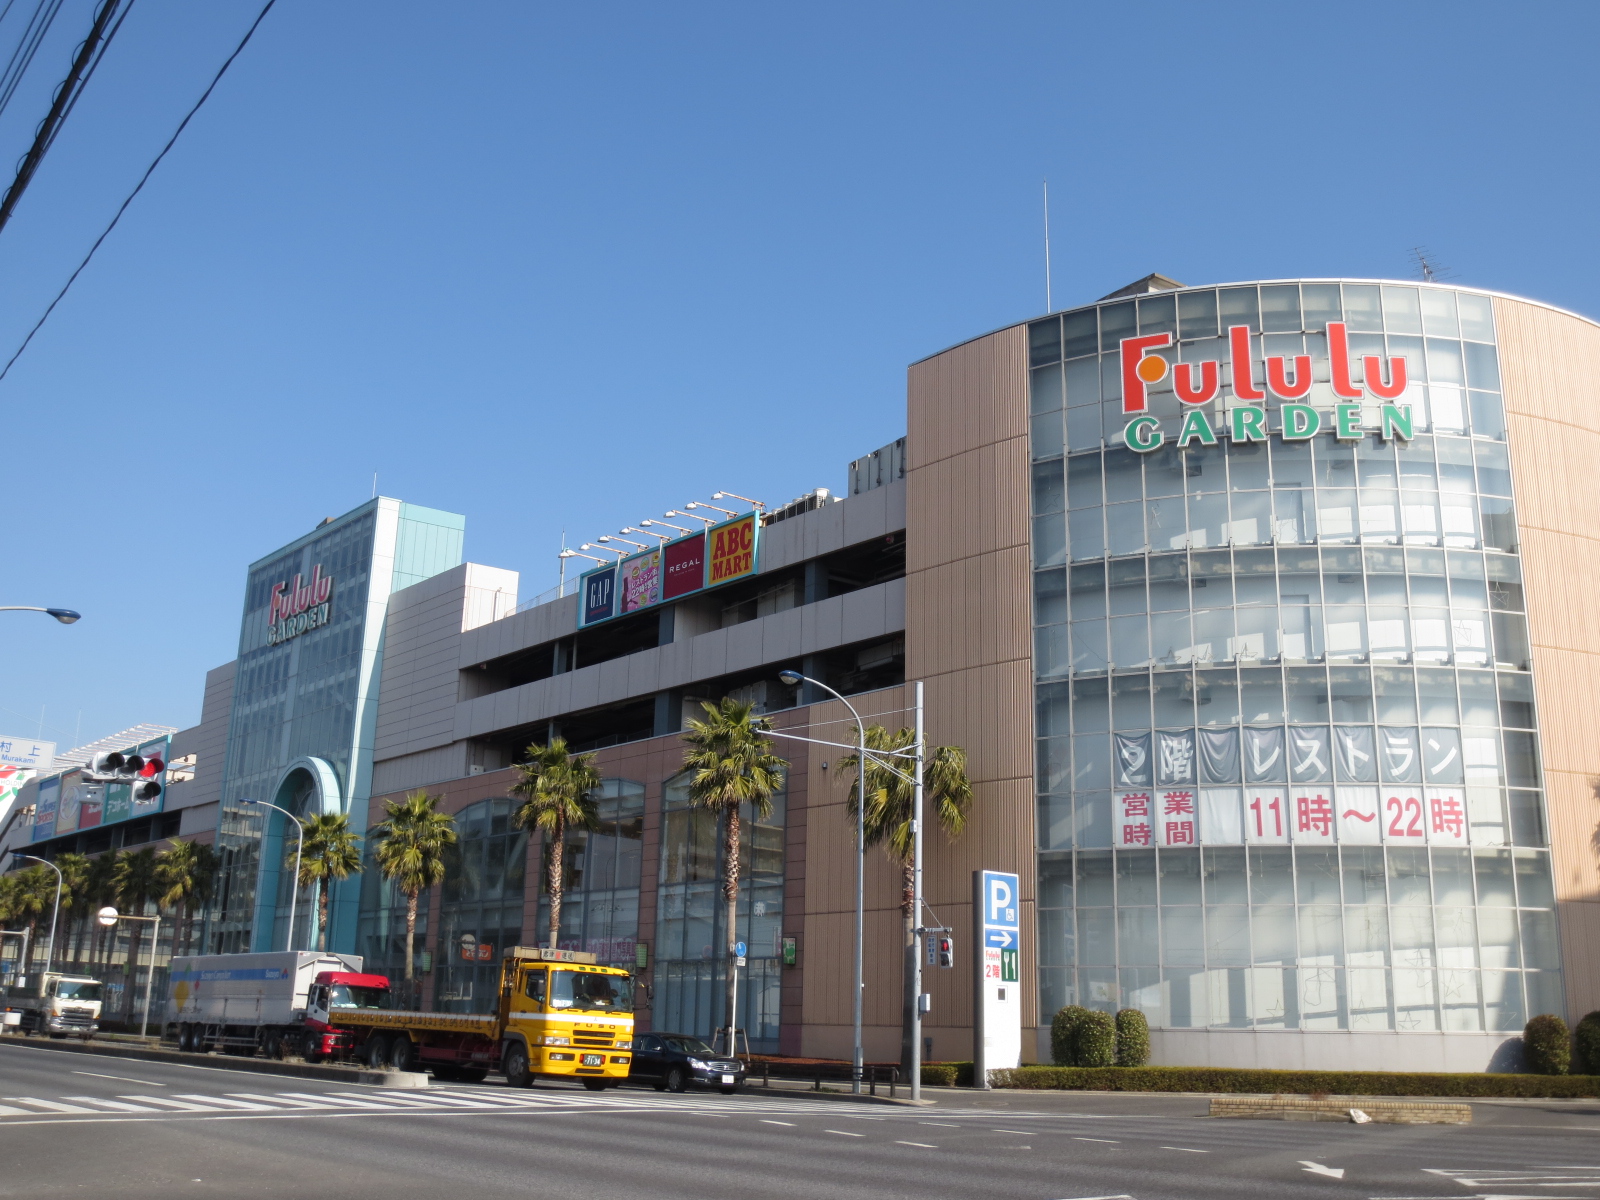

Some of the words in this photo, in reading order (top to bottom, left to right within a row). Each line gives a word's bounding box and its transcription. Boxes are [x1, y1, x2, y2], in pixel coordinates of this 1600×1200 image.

[1120, 321, 1409, 414] Fululu
[1124, 402, 1415, 453] GARDEN
[713, 522, 752, 561] ABC
[669, 558, 701, 573] REGAL
[712, 551, 752, 581] MART
[268, 563, 332, 626] Fululu
[590, 578, 610, 609] GAP
[266, 603, 329, 646] GARDEN
[1, 754, 36, 764] Murakami
[1251, 735, 1457, 777] レストラン
[991, 880, 1012, 920] P
[986, 964, 1000, 978] 2階
